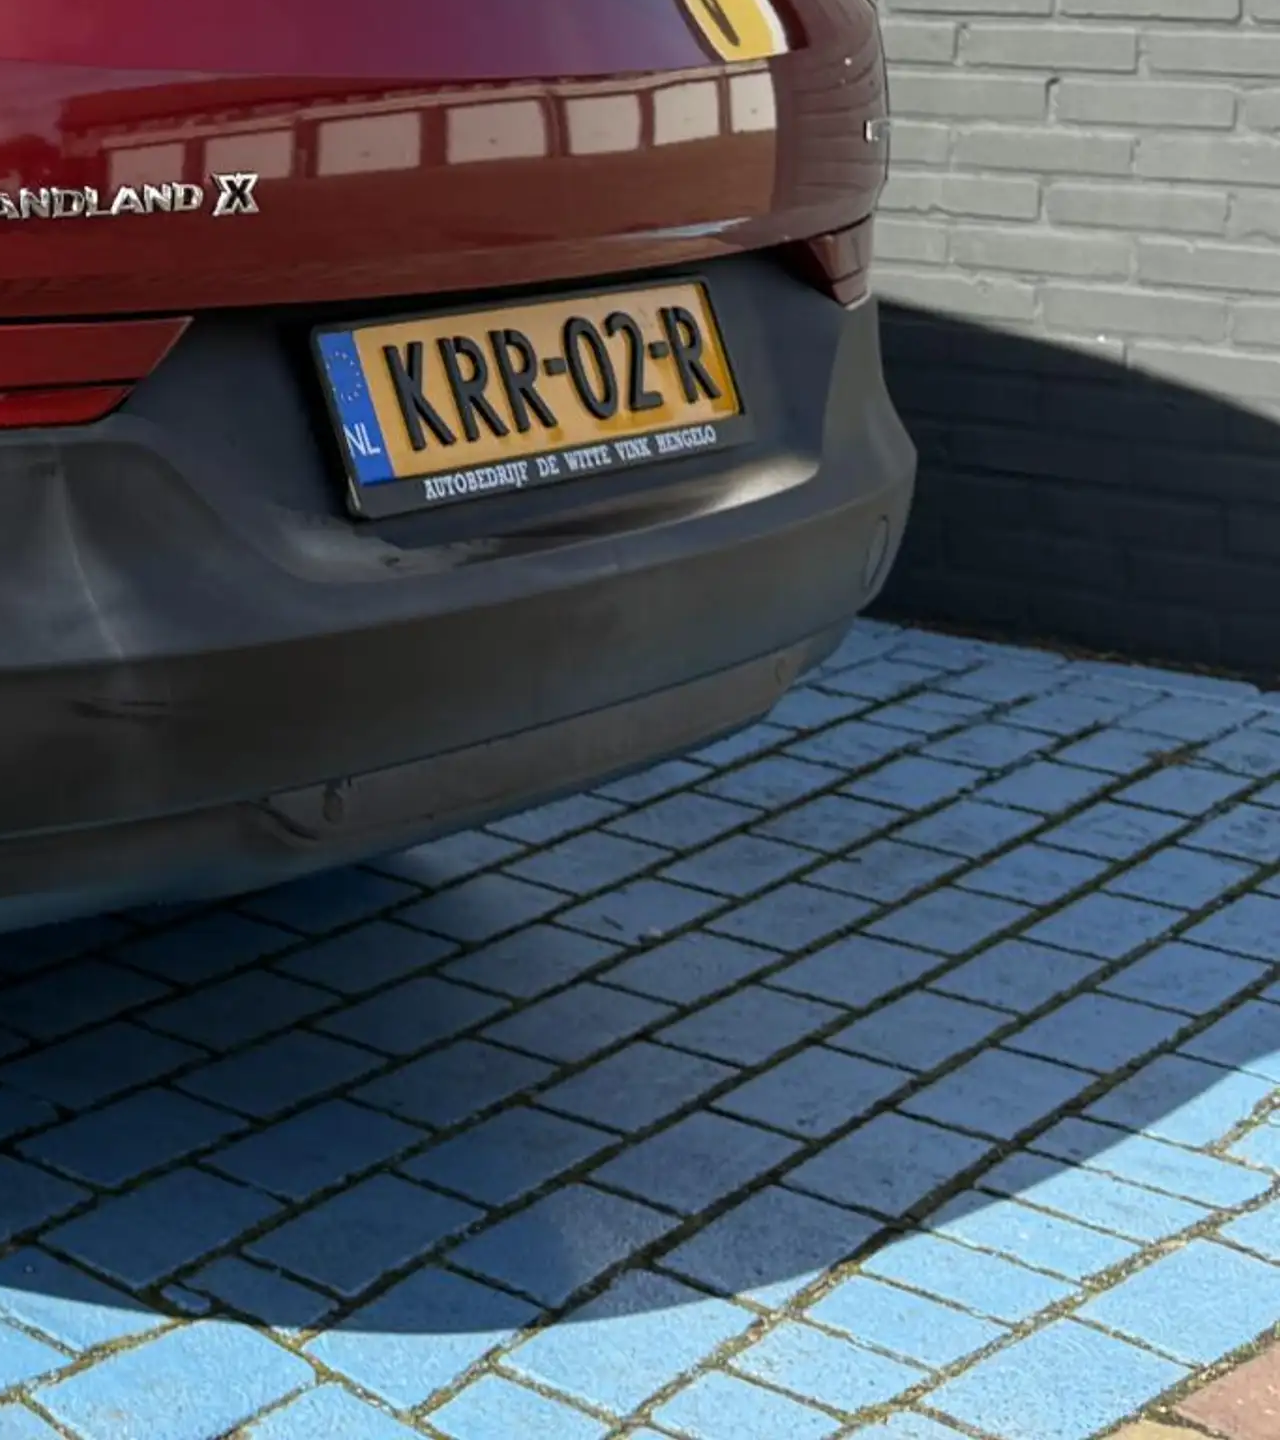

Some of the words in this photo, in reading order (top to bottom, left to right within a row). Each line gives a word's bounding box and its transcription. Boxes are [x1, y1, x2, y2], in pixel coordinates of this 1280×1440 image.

[212, 172, 260, 217] X
[382, 306, 722, 452] KRR-02-R
[343, 422, 381, 459] NL
[423, 460, 529, 500] AUTOBEDRIJF
[536, 456, 561, 478] DE
[563, 447, 613, 472] WITTE
[614, 437, 651, 461] VINK
[656, 424, 718, 453] HENGELO
